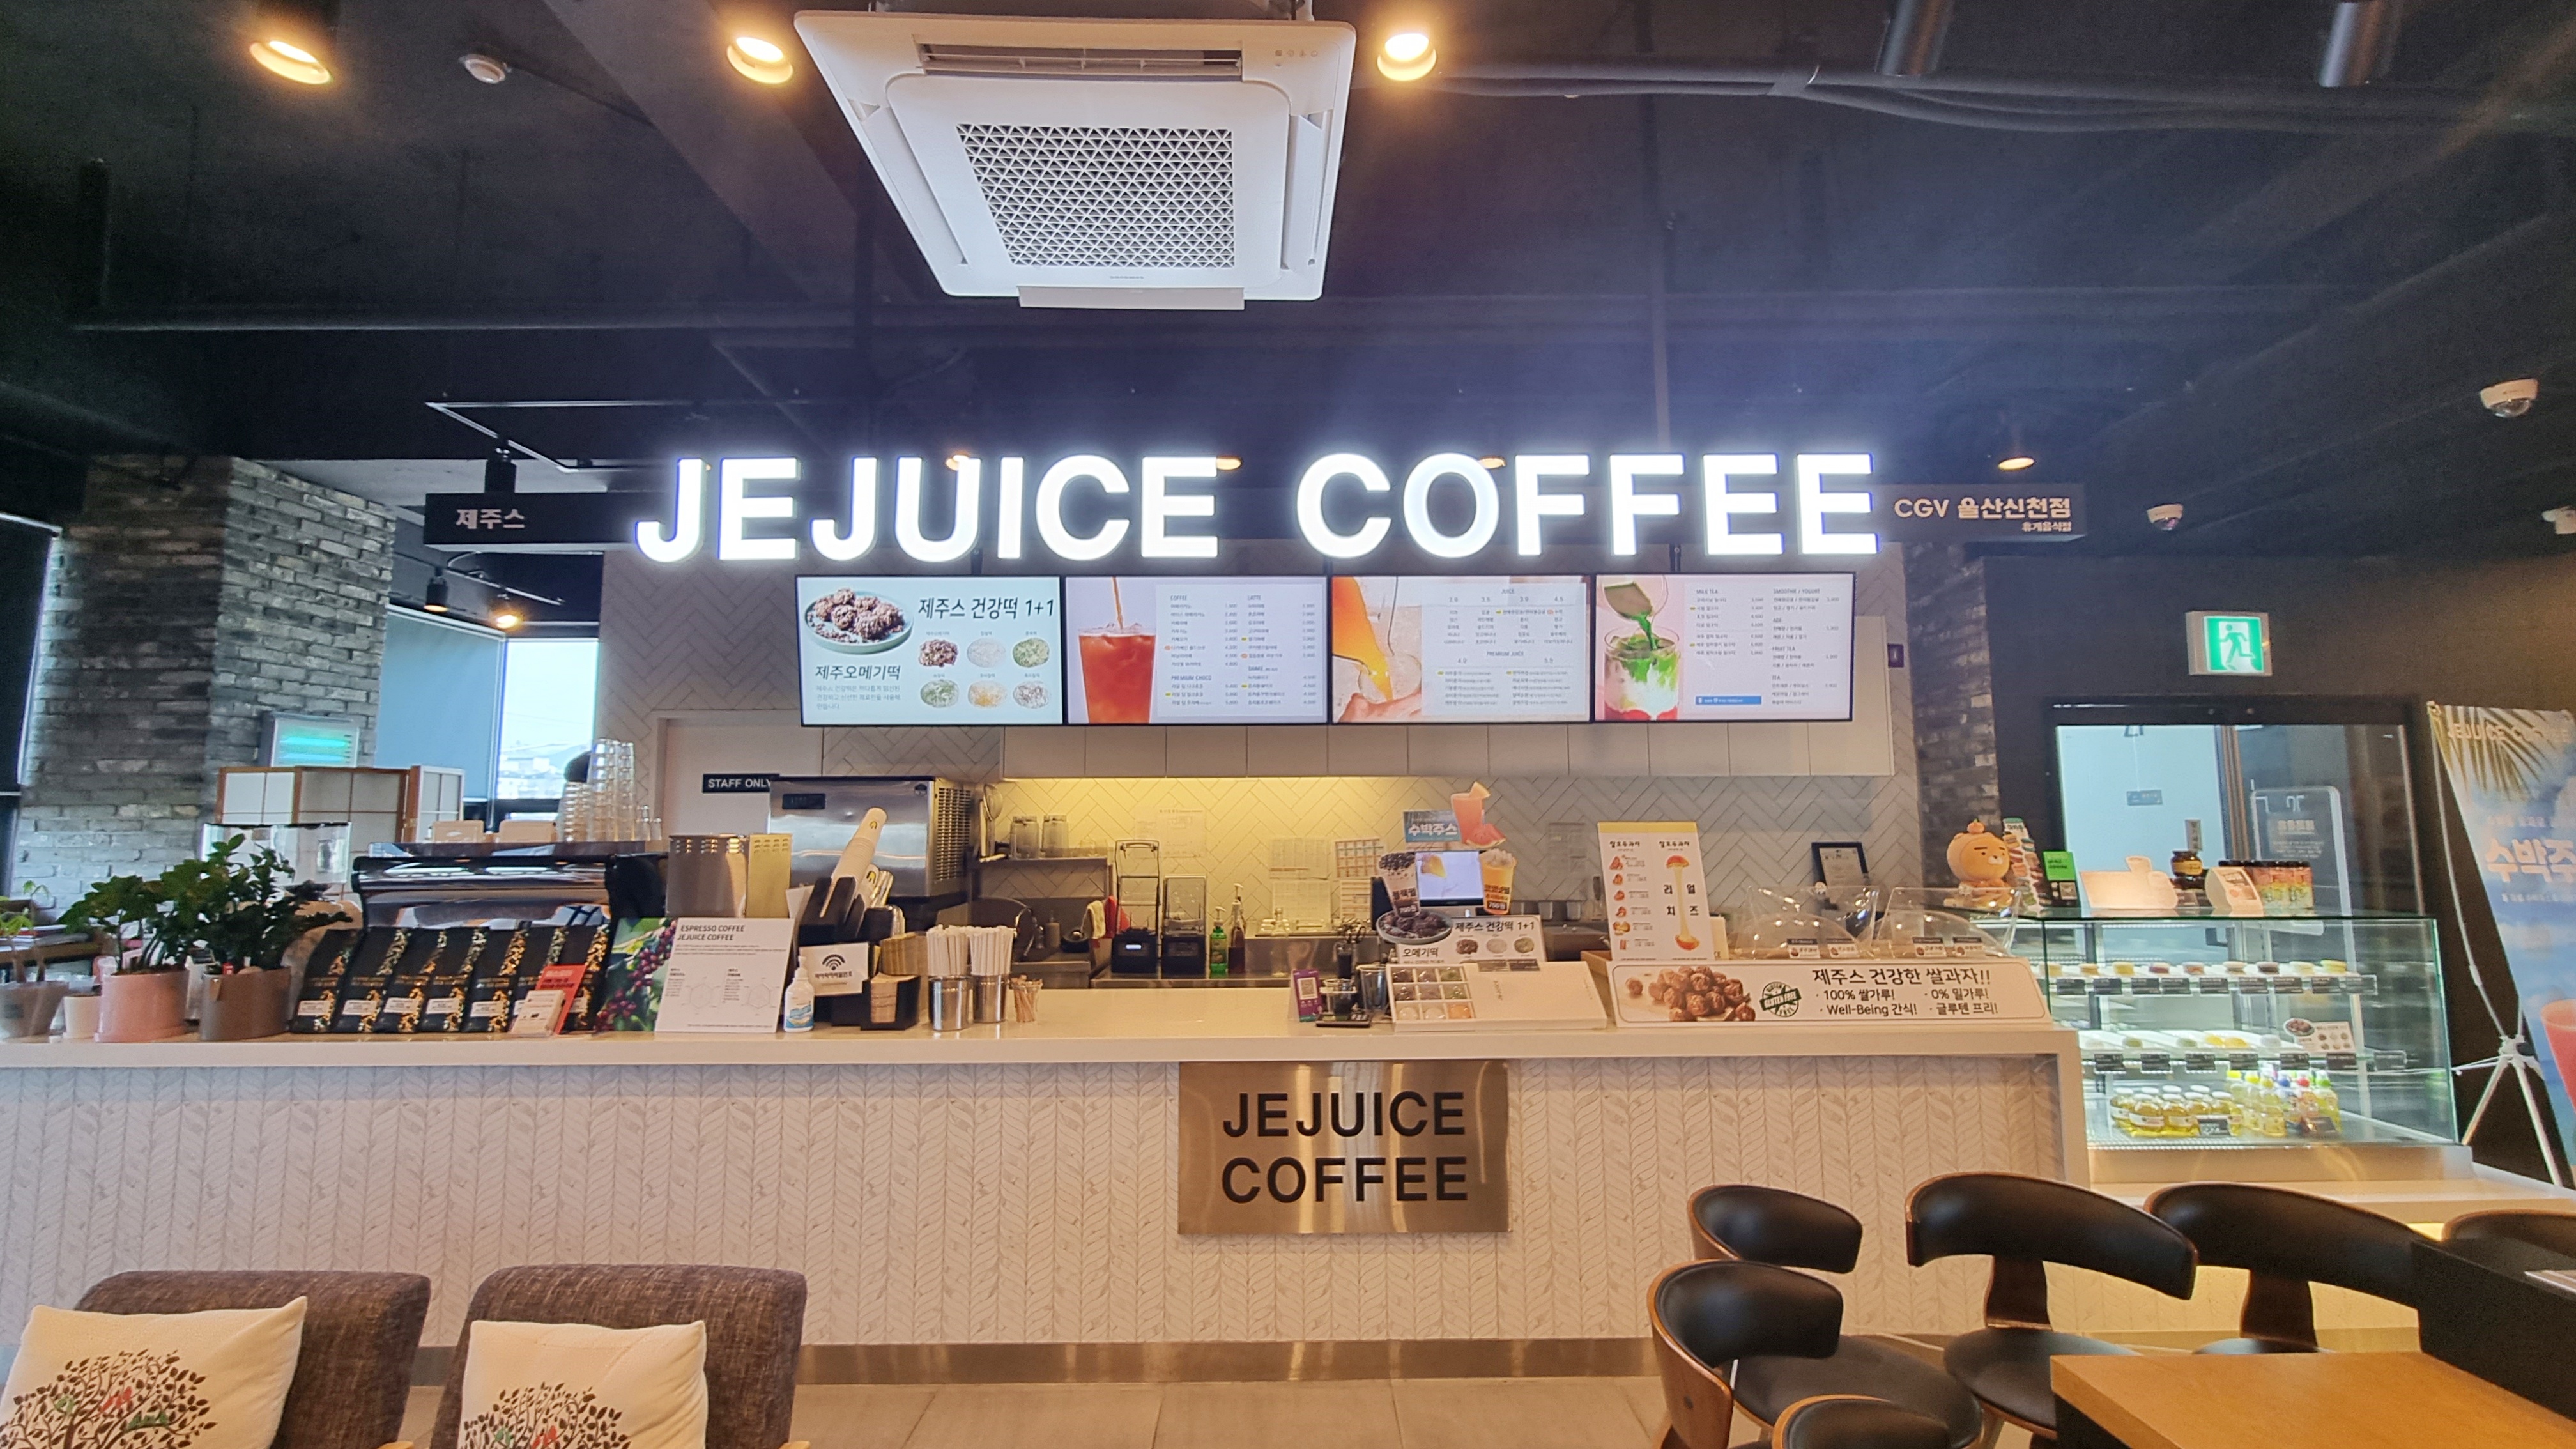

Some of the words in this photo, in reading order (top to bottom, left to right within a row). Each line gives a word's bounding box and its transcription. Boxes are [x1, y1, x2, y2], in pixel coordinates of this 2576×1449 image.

[635, 456, 1221, 564] JEJUICE
[1296, 452, 1877, 561] COFFEE
[1893, 498, 1950, 519] CGV
[1957, 496, 2072, 520] 울산신천점
[455, 509, 526, 531] 제주스
[2021, 521, 2072, 532] 휴게음식점
[918, 597, 965, 620] 제주스
[970, 596, 1018, 620] 건강떡
[1024, 599, 1055, 617] 1+1
[815, 664, 901, 681] 제주오메기떡
[707, 778, 742, 788] STAFF
[745, 778, 771, 788] ONLY
[1408, 822, 1459, 836] 수박주스
[1664, 884, 1673, 894] 리
[1686, 884, 1696, 894] 얼
[1667, 905, 1675, 916] 치
[1690, 905, 1699, 916] 즈
[1455, 921, 1483, 931] 제주스
[1486, 921, 1514, 931] 건강떡
[1517, 921, 1535, 930] 1+1
[1402, 947, 1438, 958] 오메기떡
[1812, 969, 1866, 985] 제주스
[1870, 969, 1922, 985] 건강한
[1926, 969, 1991, 985] 쌀과자!!
[1823, 990, 1856, 1001] 100%
[1858, 989, 1896, 1002] 쌀가루!
[1931, 990, 1950, 1000] 0%
[1952, 988, 1989, 1001] 밀가루!
[1827, 1004, 1889, 1018] Well-Being
[1892, 1003, 1918, 1017] 간식!
[1936, 1002, 1970, 1016] 글루텐
[1973, 1002, 1999, 1016] 프리!
[1223, 1090, 1466, 1138] JEJUICE
[1221, 1156, 1468, 1204] COFFEE
